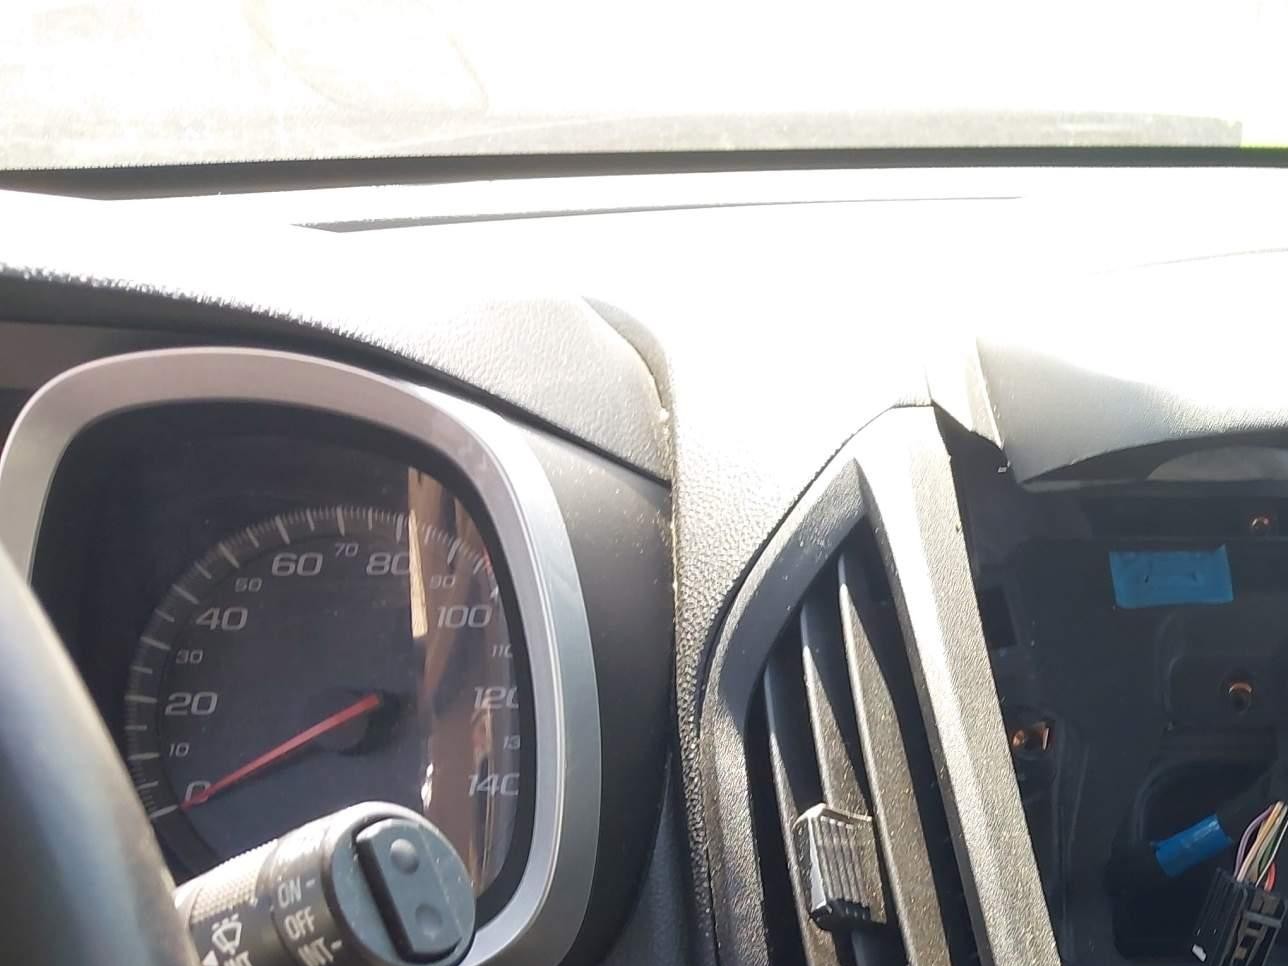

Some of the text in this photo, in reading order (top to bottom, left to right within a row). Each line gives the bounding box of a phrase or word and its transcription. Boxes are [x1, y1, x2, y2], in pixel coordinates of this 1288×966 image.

[335, 542, 359, 557] 70
[271, 552, 323, 577] 60
[366, 552, 411, 576] 80
[234, 578, 263, 592] 50
[430, 574, 456, 589] 90
[196, 607, 248, 631] 40
[436, 605, 493, 629] 100
[175, 650, 203, 664] 30
[165, 692, 218, 716] 20
[169, 743, 190, 757] 10
[503, 734, 521, 750] 13
[184, 780, 212, 804] 0
[277, 877, 302, 908] ON
[285, 906, 316, 941] OFF
